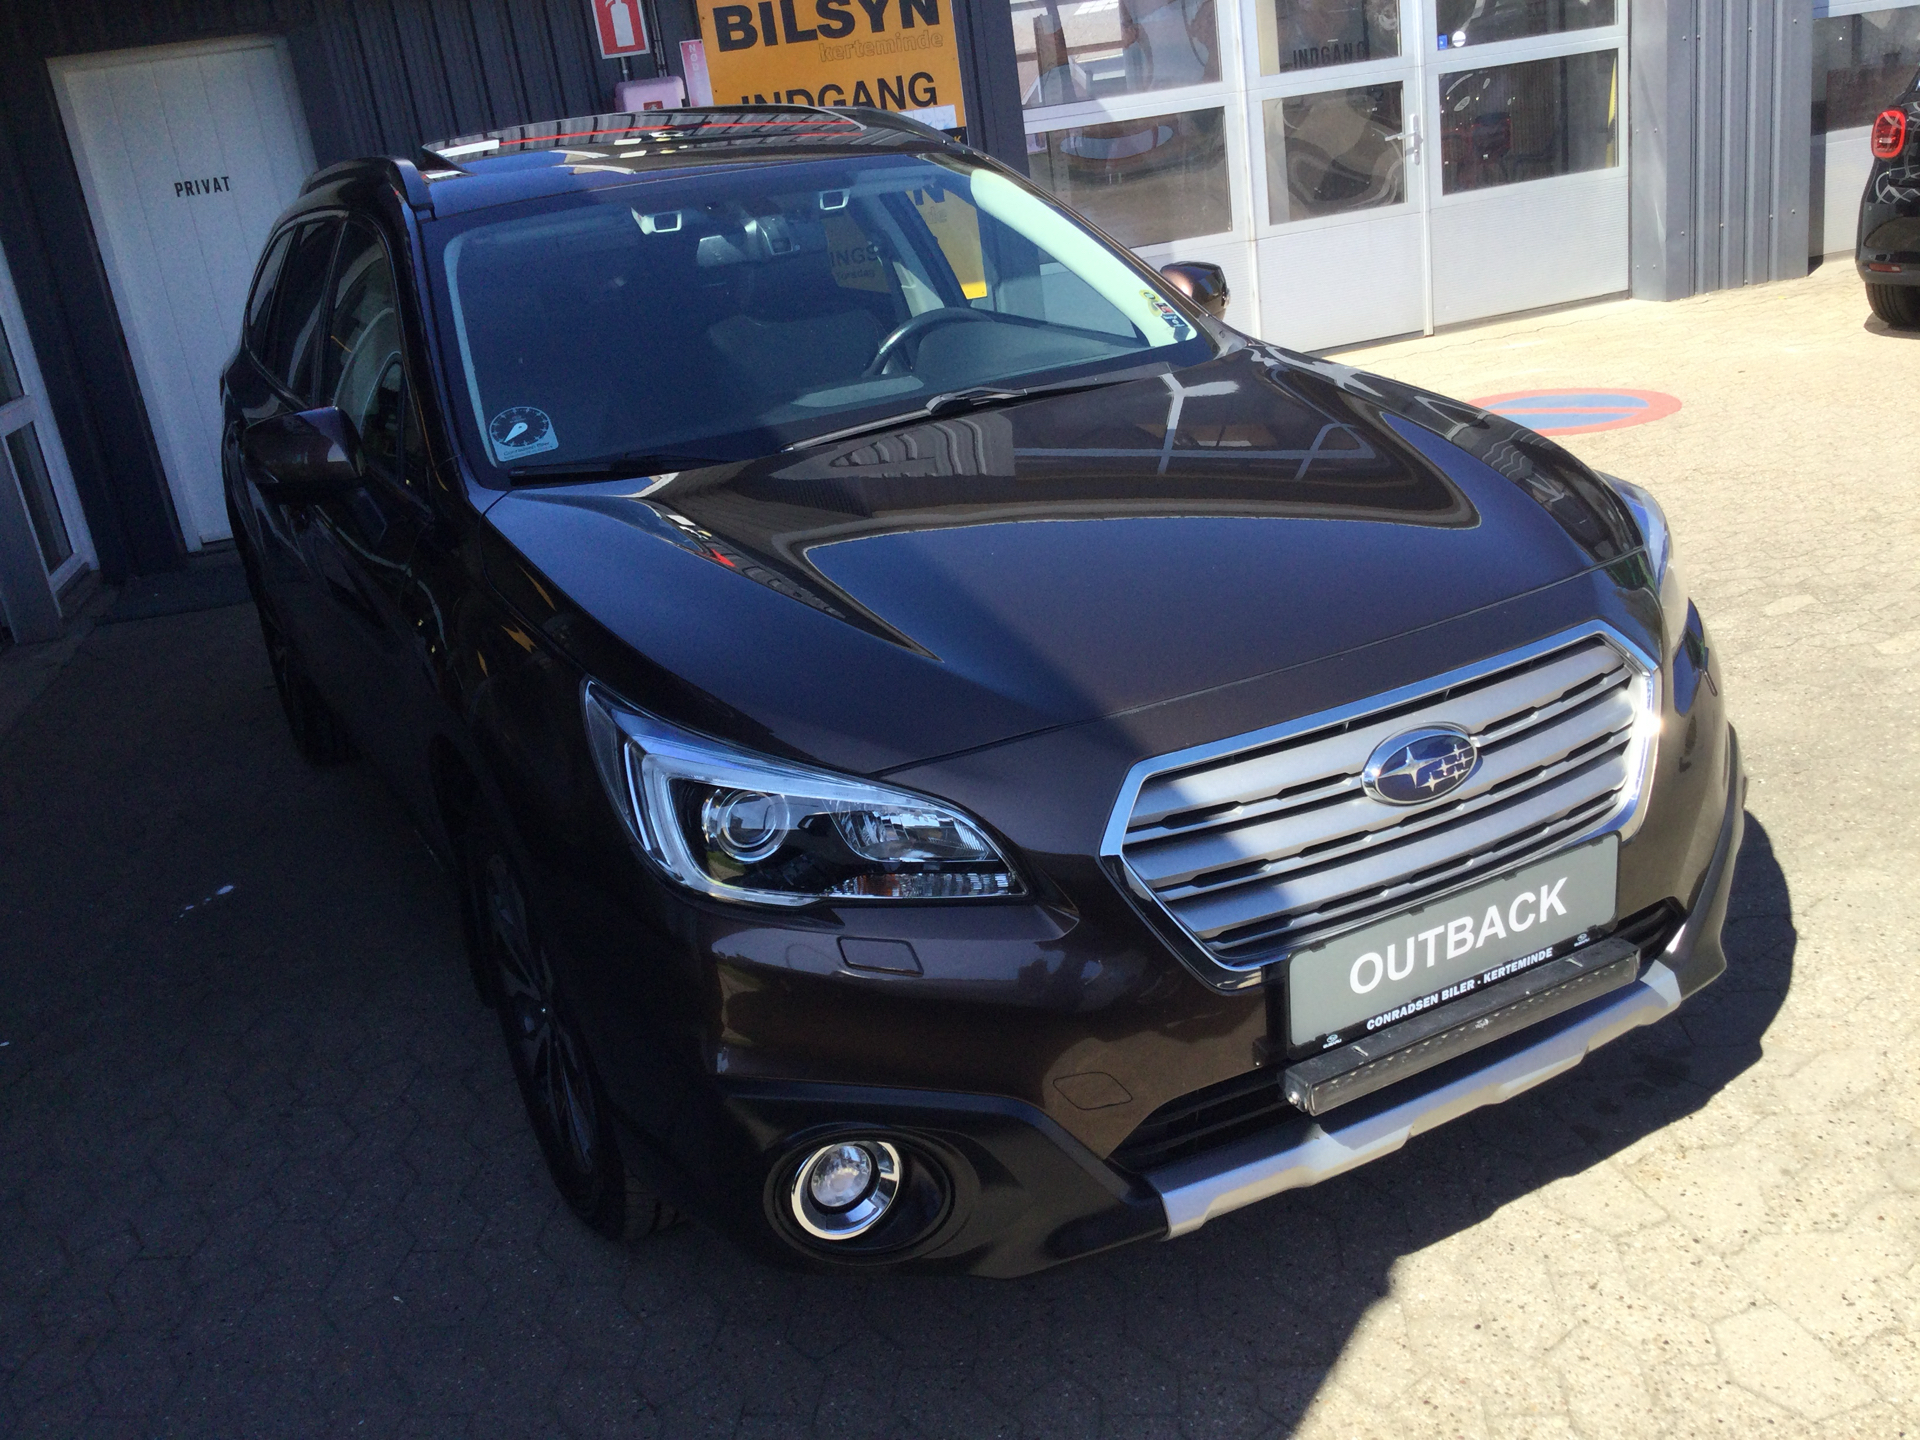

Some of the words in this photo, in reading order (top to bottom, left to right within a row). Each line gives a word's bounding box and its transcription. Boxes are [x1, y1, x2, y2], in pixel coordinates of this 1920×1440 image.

[712, 0, 941, 53] BILSYN
[818, 30, 944, 63] kerteminde
[741, 71, 938, 112] GANG
[174, 176, 230, 198] PRIVAT
[1349, 876, 1569, 995] OUTBACK
[1366, 993, 1438, 1031] CONRADSEN
[1441, 979, 1475, 1003] BILER
[1483, 947, 1554, 983] KERTEMINDE
